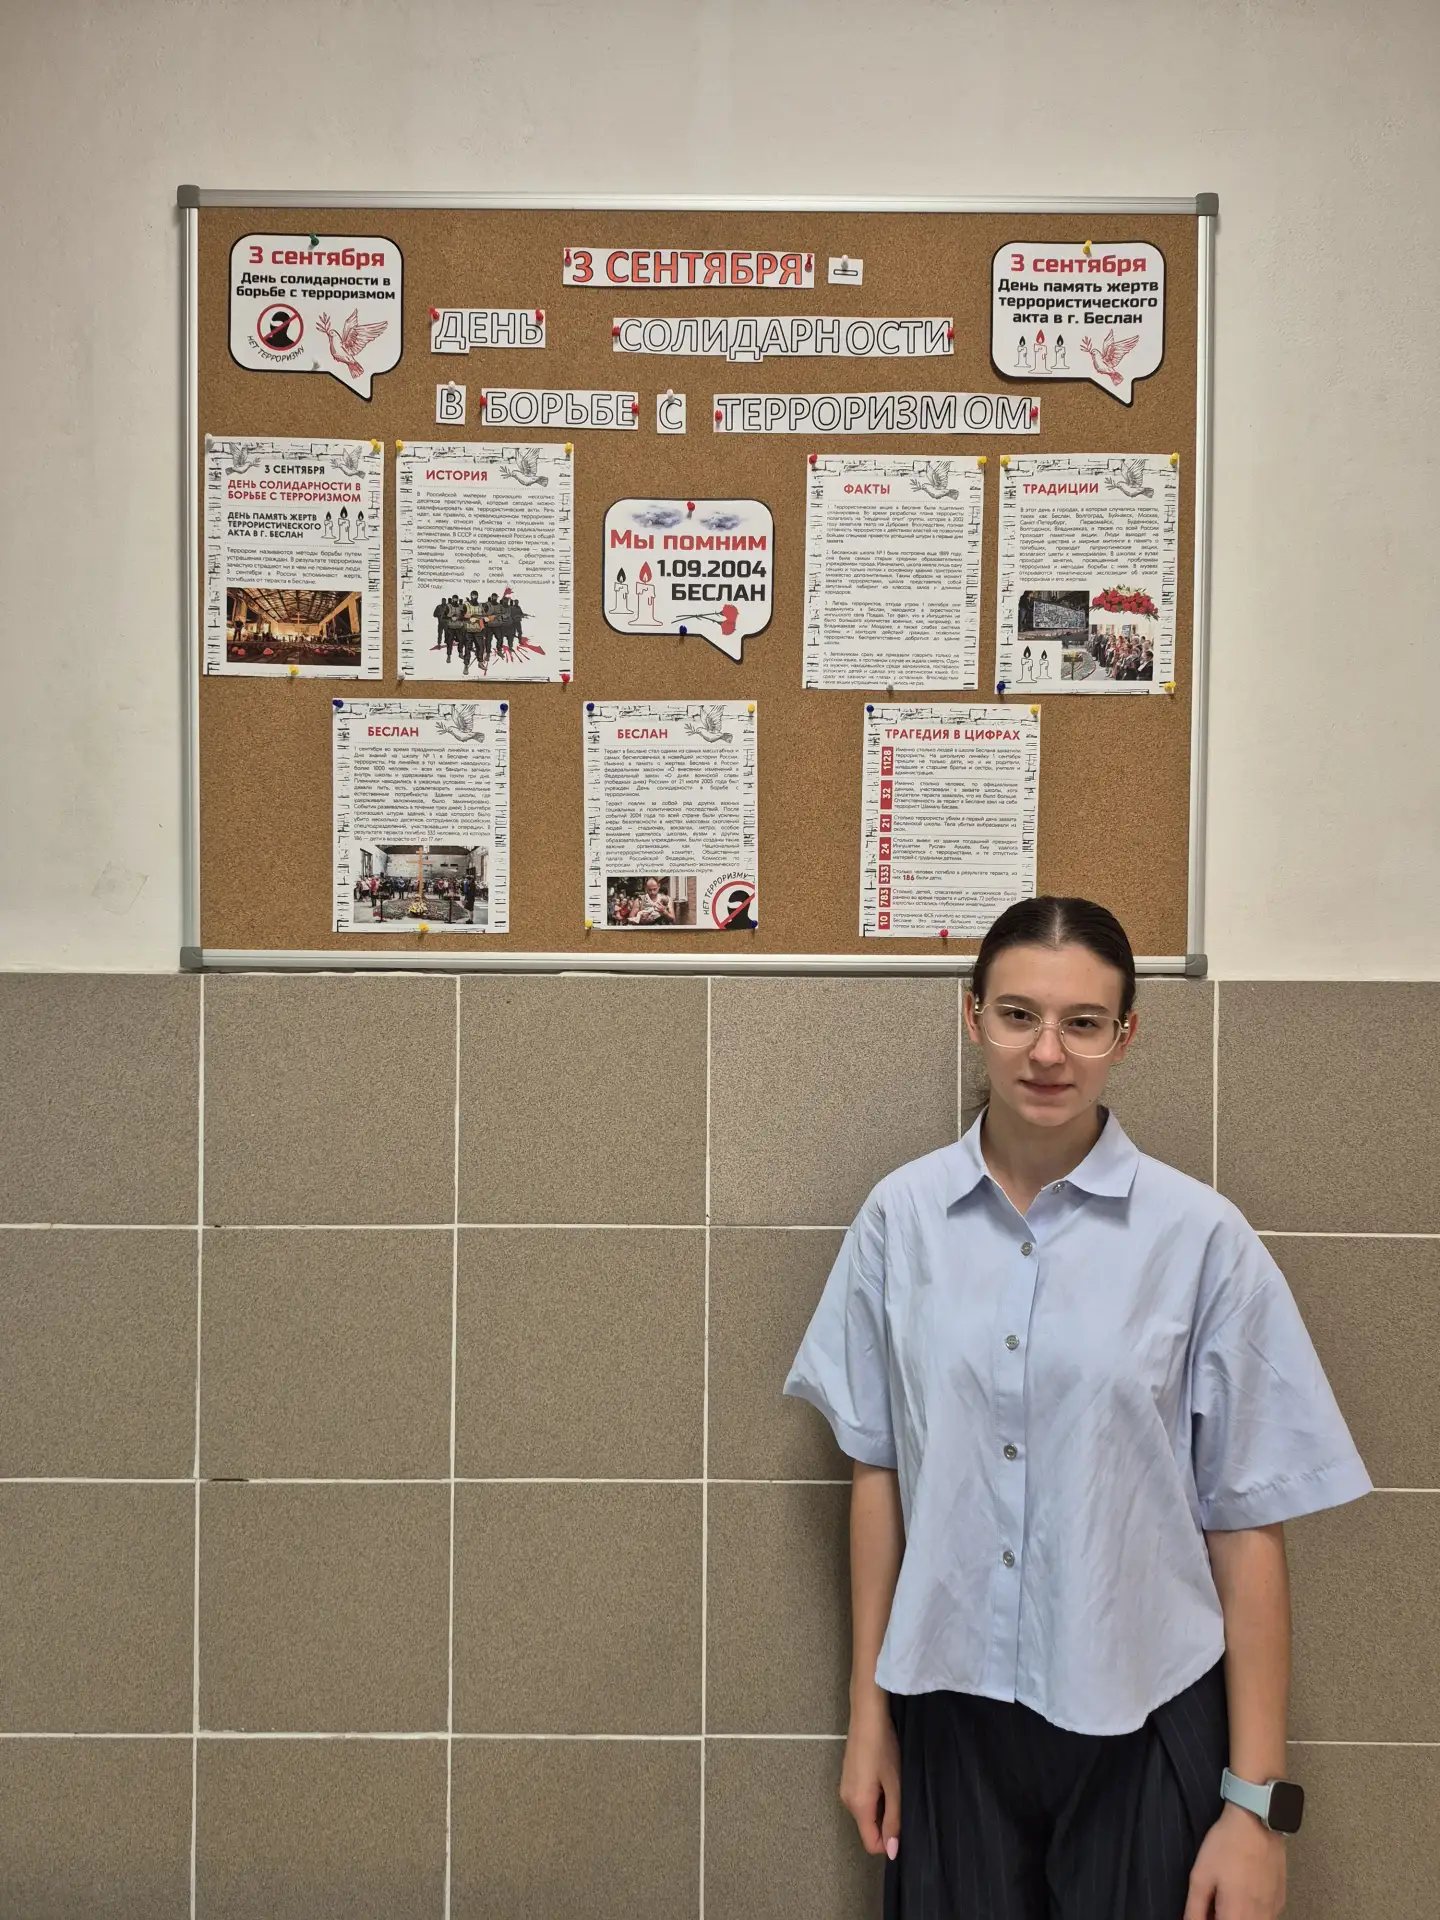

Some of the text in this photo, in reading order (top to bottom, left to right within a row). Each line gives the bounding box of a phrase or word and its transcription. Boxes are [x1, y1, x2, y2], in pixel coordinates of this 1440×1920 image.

[249, 246, 384, 270] 3 сентября
[572, 251, 594, 282] 3
[606, 251, 802, 284] СЕНТЯБРЯ
[1011, 254, 1146, 276] 3 сентября
[241, 272, 390, 287] День солидарности в
[236, 286, 395, 300] борьбе с терроризмом
[998, 279, 1158, 294] День память жертв
[999, 297, 1157, 310] террористического
[1013, 312, 1142, 324] акта в г. Беслан
[435, 312, 950, 360] ДЕНЬ СОЛИДАРНОСТИ
[247, 335, 304, 362] НЕТ ТЕРРОРИЗМУ
[440, 388, 1032, 431] В БОРЬБЕ С ТЕРРОРИЗМОМ
[265, 465, 325, 474] 3 СЕНТЯБРЯ
[426, 470, 487, 481] ИСТОРИЯ
[228, 480, 256, 488] ДЕНЬ
[260, 481, 351, 491] СОЛИДАРНОСТИ
[844, 484, 890, 494] ФАКТЫ
[1023, 483, 1098, 495] ТРАДИЦИИ
[228, 491, 361, 502] БОРЬБЕ С ТЕРРОРИЗМОМ
[228, 521, 321, 530] ТЕРРОРИСТИЧЕСКОГО
[611, 530, 766, 550] Мы помним
[657, 560, 766, 577] 1.09.2004
[671, 583, 765, 601] БЕСЛАН
[368, 727, 418, 737] БЕСЛАН
[618, 729, 668, 739] БЕСЛАН
[885, 729, 1020, 741] ТРАГЕДИЯ В ЦИФРАХ
[883, 788, 891, 799] 32
[882, 818, 890, 828] 21
[881, 843, 889, 854] 24
[881, 866, 889, 882] 333
[705, 872, 748, 898] ТЕРРОРИЗМУ
[880, 889, 888, 906] 783
[880, 915, 888, 926] 10
